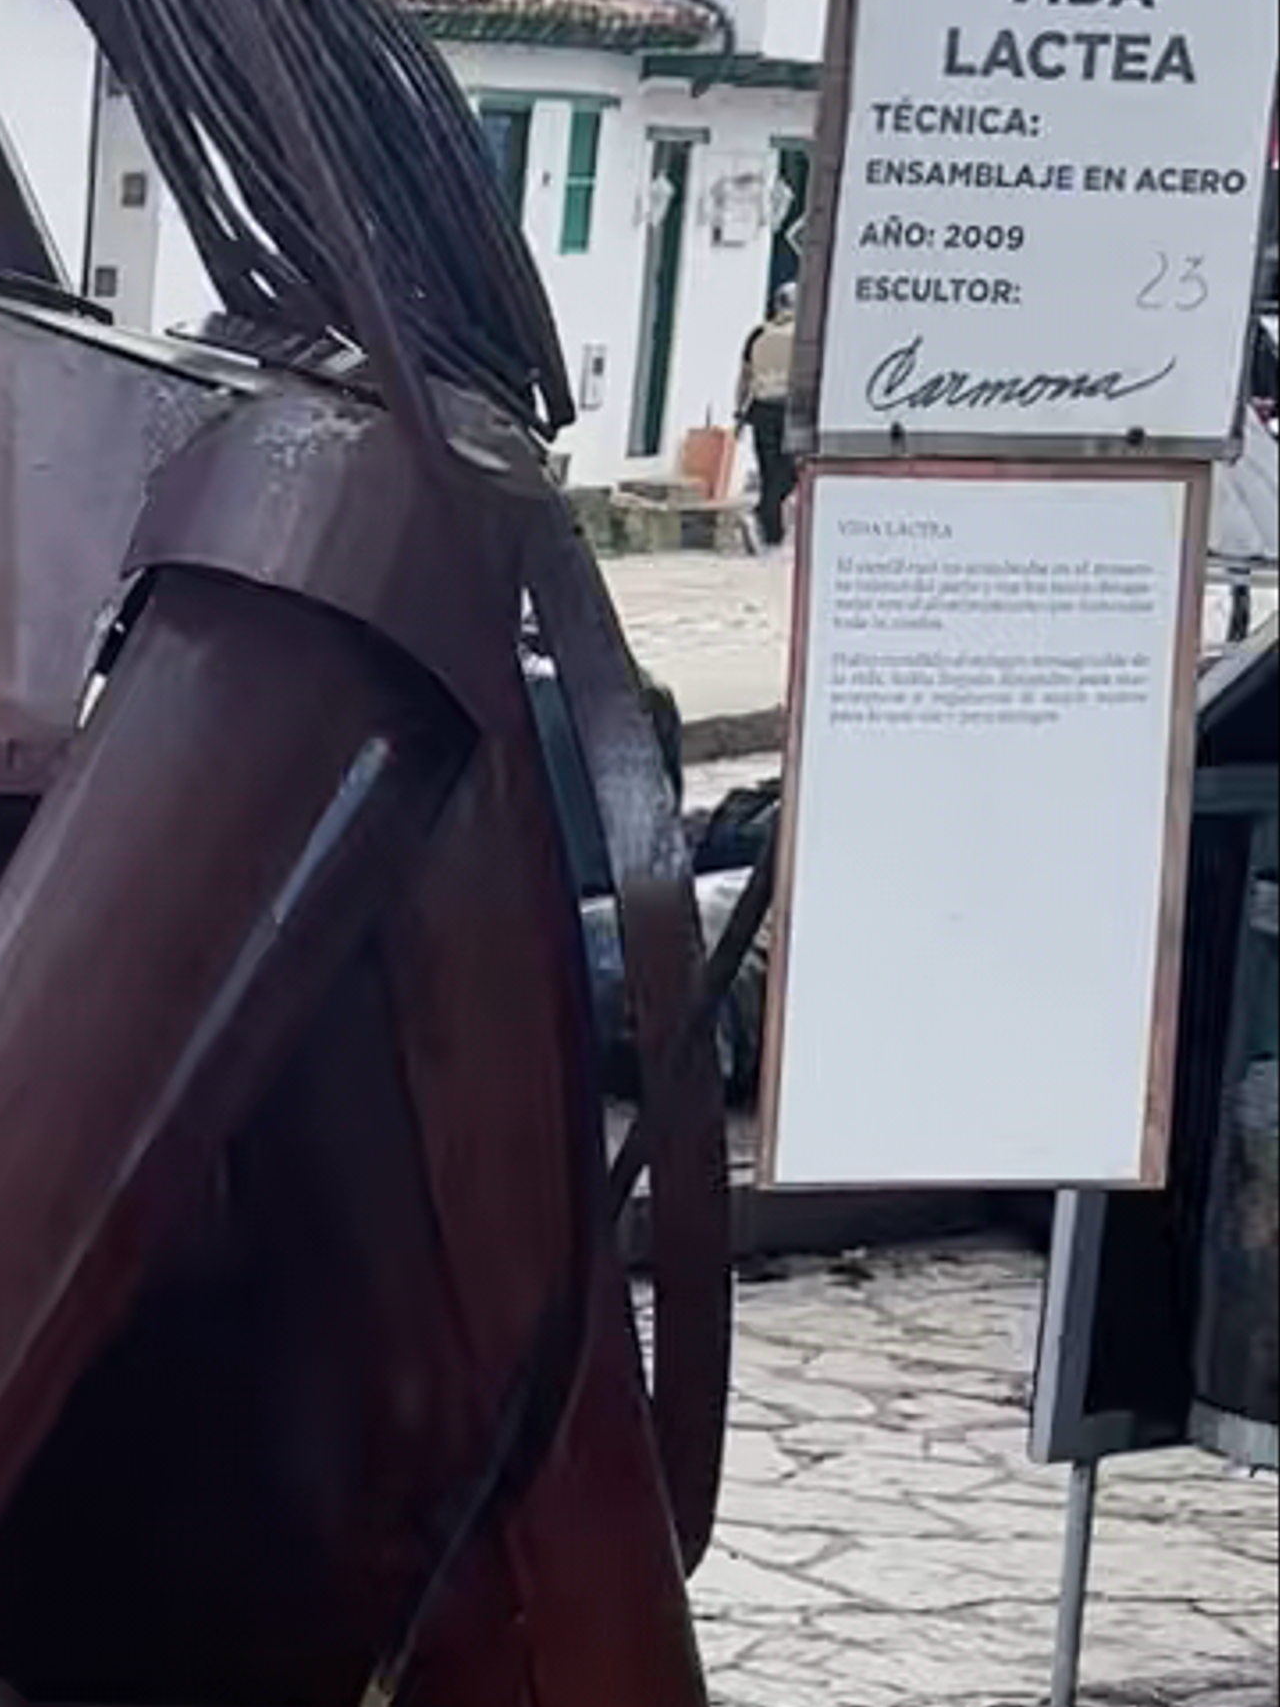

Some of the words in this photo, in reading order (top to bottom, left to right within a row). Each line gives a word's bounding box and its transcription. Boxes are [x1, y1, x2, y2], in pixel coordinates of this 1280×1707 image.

[943, 27, 1195, 83] LACTEA
[872, 97, 1039, 136] TÉCNICA:
[866, 158, 1075, 189] ENSAMBLAJE
[1083, 166, 1126, 191] EN
[1135, 168, 1247, 193] ACERO
[859, 216, 935, 247] AÑO:
[944, 225, 1024, 249] 2009
[855, 277, 1021, 303] ESCULTOR:
[866, 336, 1176, 410] Carmona
